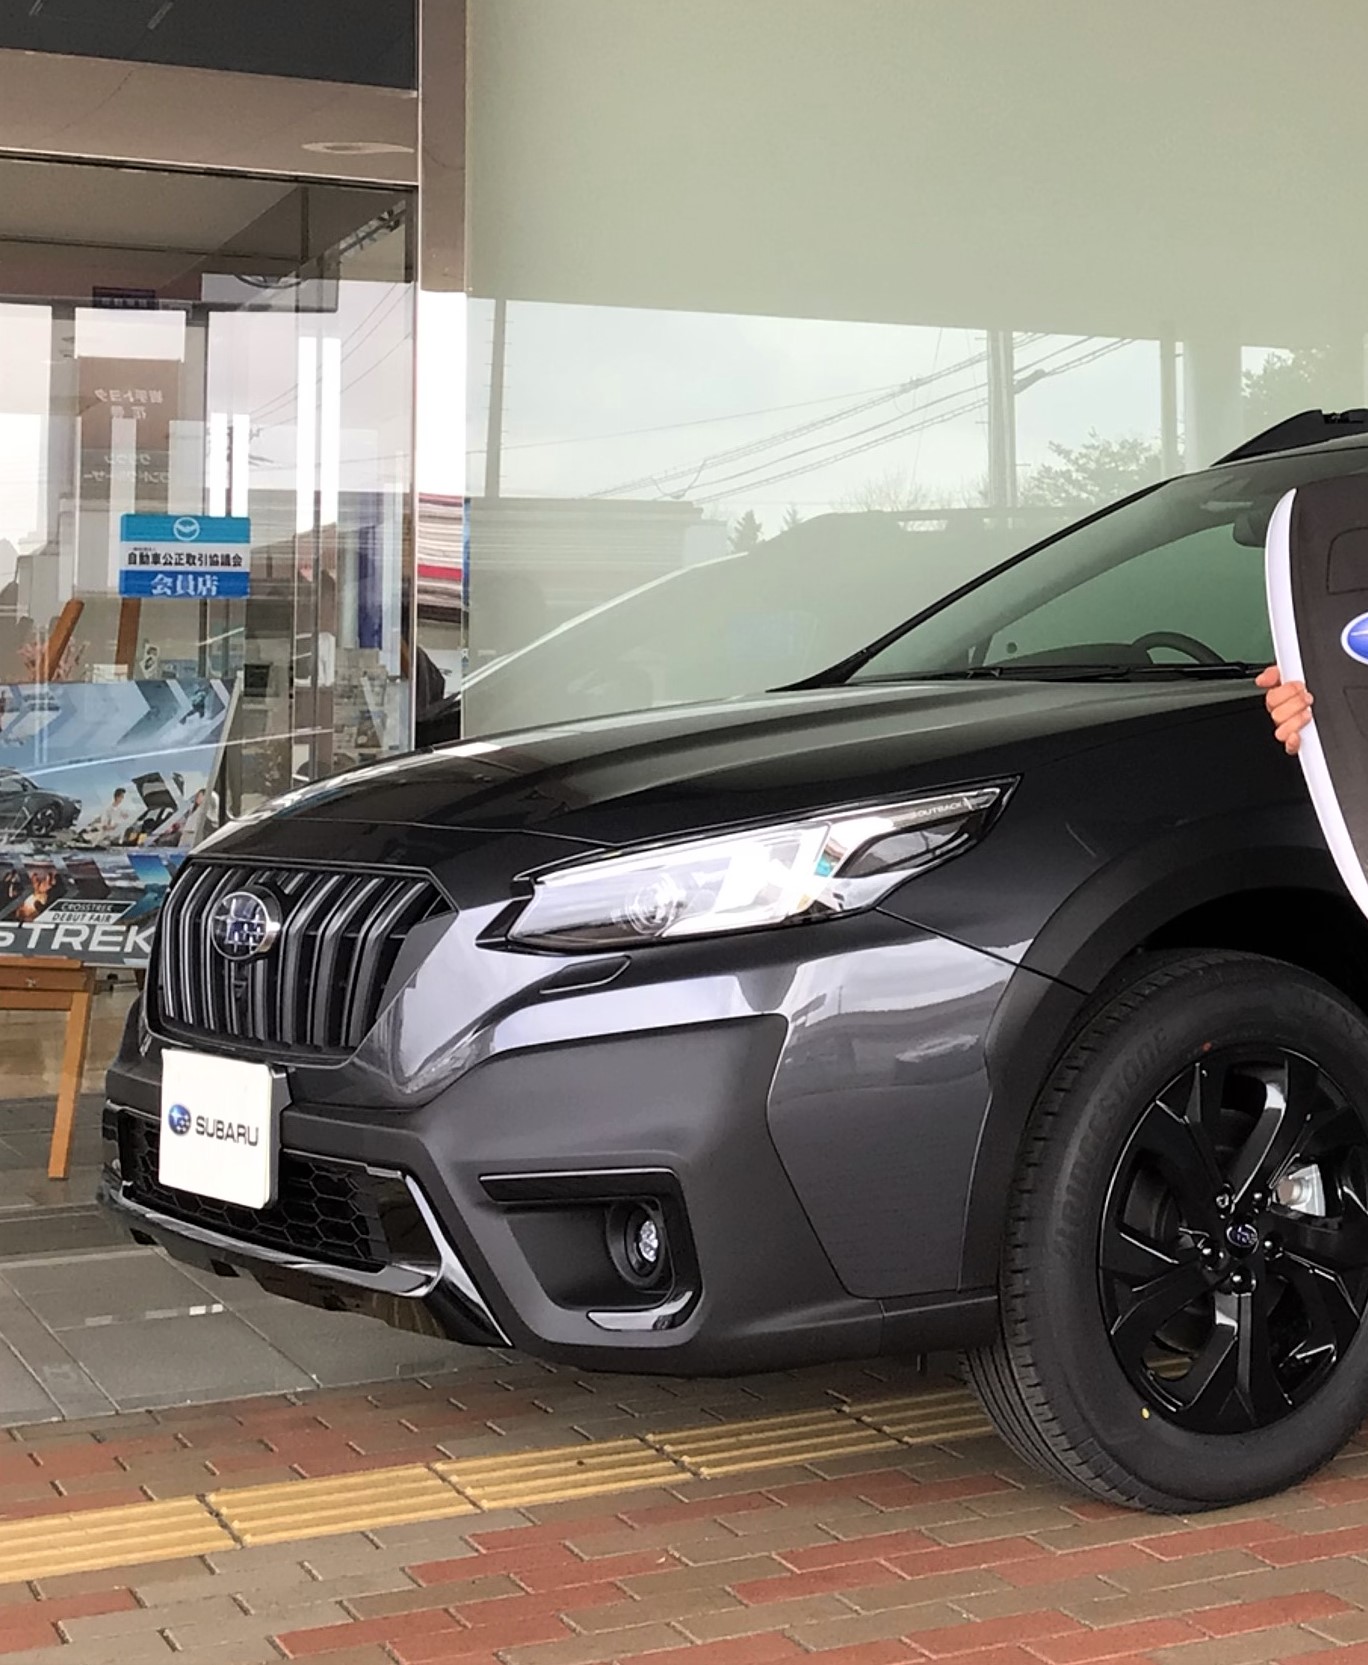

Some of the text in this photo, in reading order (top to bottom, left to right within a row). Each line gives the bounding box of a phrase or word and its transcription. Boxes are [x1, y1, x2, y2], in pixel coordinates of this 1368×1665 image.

[127, 551, 243, 568] 自動車公正取引協議会
[150, 573, 219, 597] 会員店
[915, 801, 963, 818] OUTBACK
[61, 901, 114, 912] CROSSTREK
[52, 912, 113, 924] DEBUT FAIR
[195, 1114, 260, 1147] SUBARU
